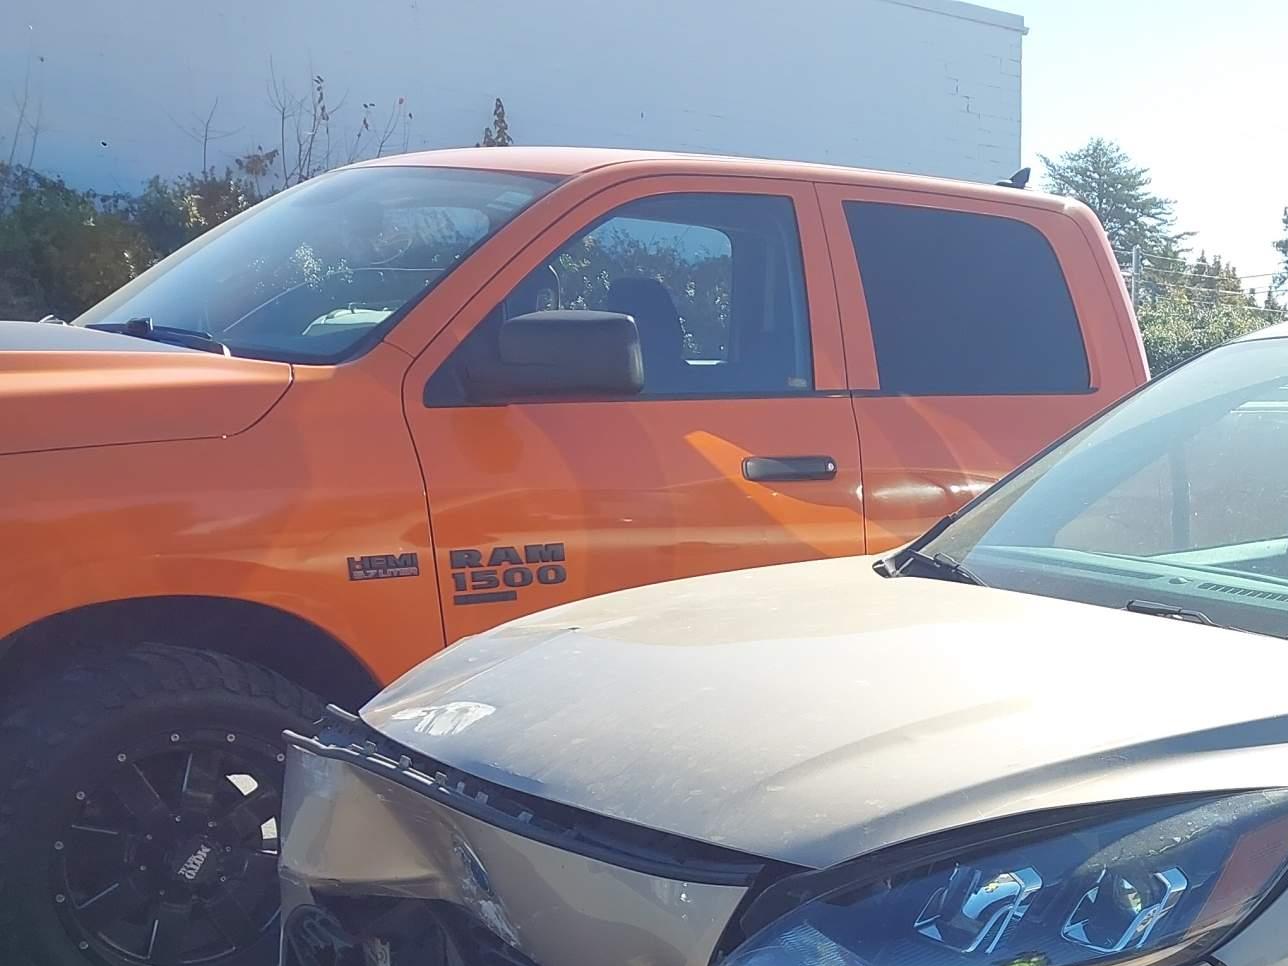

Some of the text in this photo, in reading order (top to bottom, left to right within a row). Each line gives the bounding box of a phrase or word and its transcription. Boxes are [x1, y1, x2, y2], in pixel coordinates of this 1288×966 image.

[347, 553, 418, 574] HEMI
[450, 543, 566, 568] RAM
[452, 564, 567, 591] 1500
[185, 844, 211, 880] MOTO
